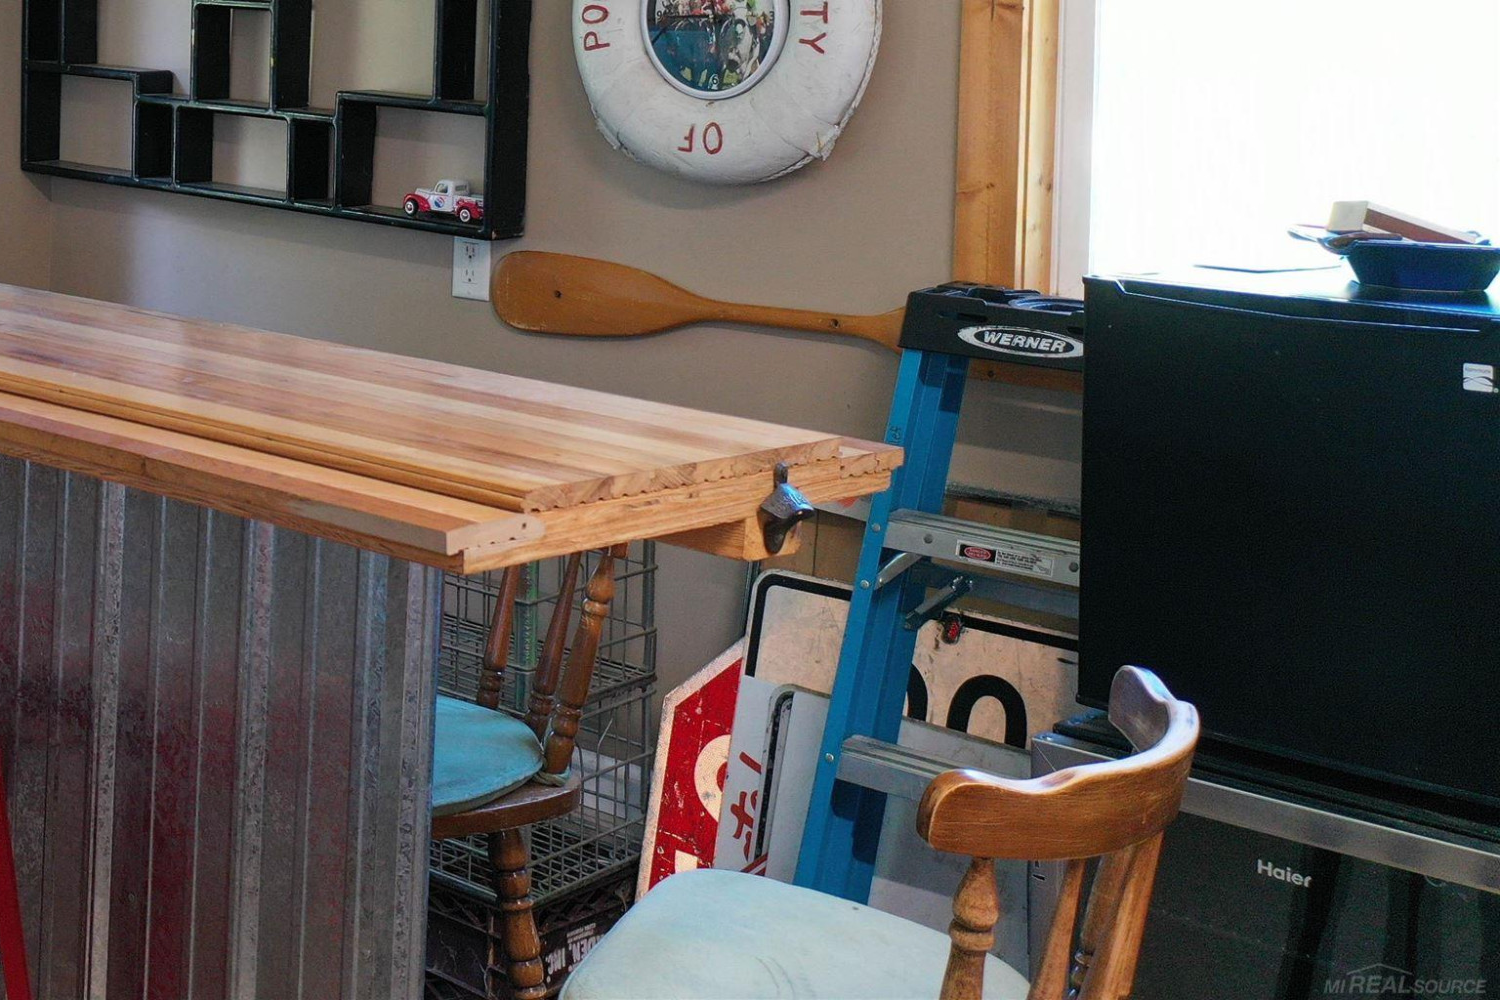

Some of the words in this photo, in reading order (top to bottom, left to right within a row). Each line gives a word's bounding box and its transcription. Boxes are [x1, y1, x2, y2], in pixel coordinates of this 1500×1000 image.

[677, 122, 723, 154] OF
[984, 331, 1066, 352] WERNER
[1257, 859, 1312, 888] Haier
